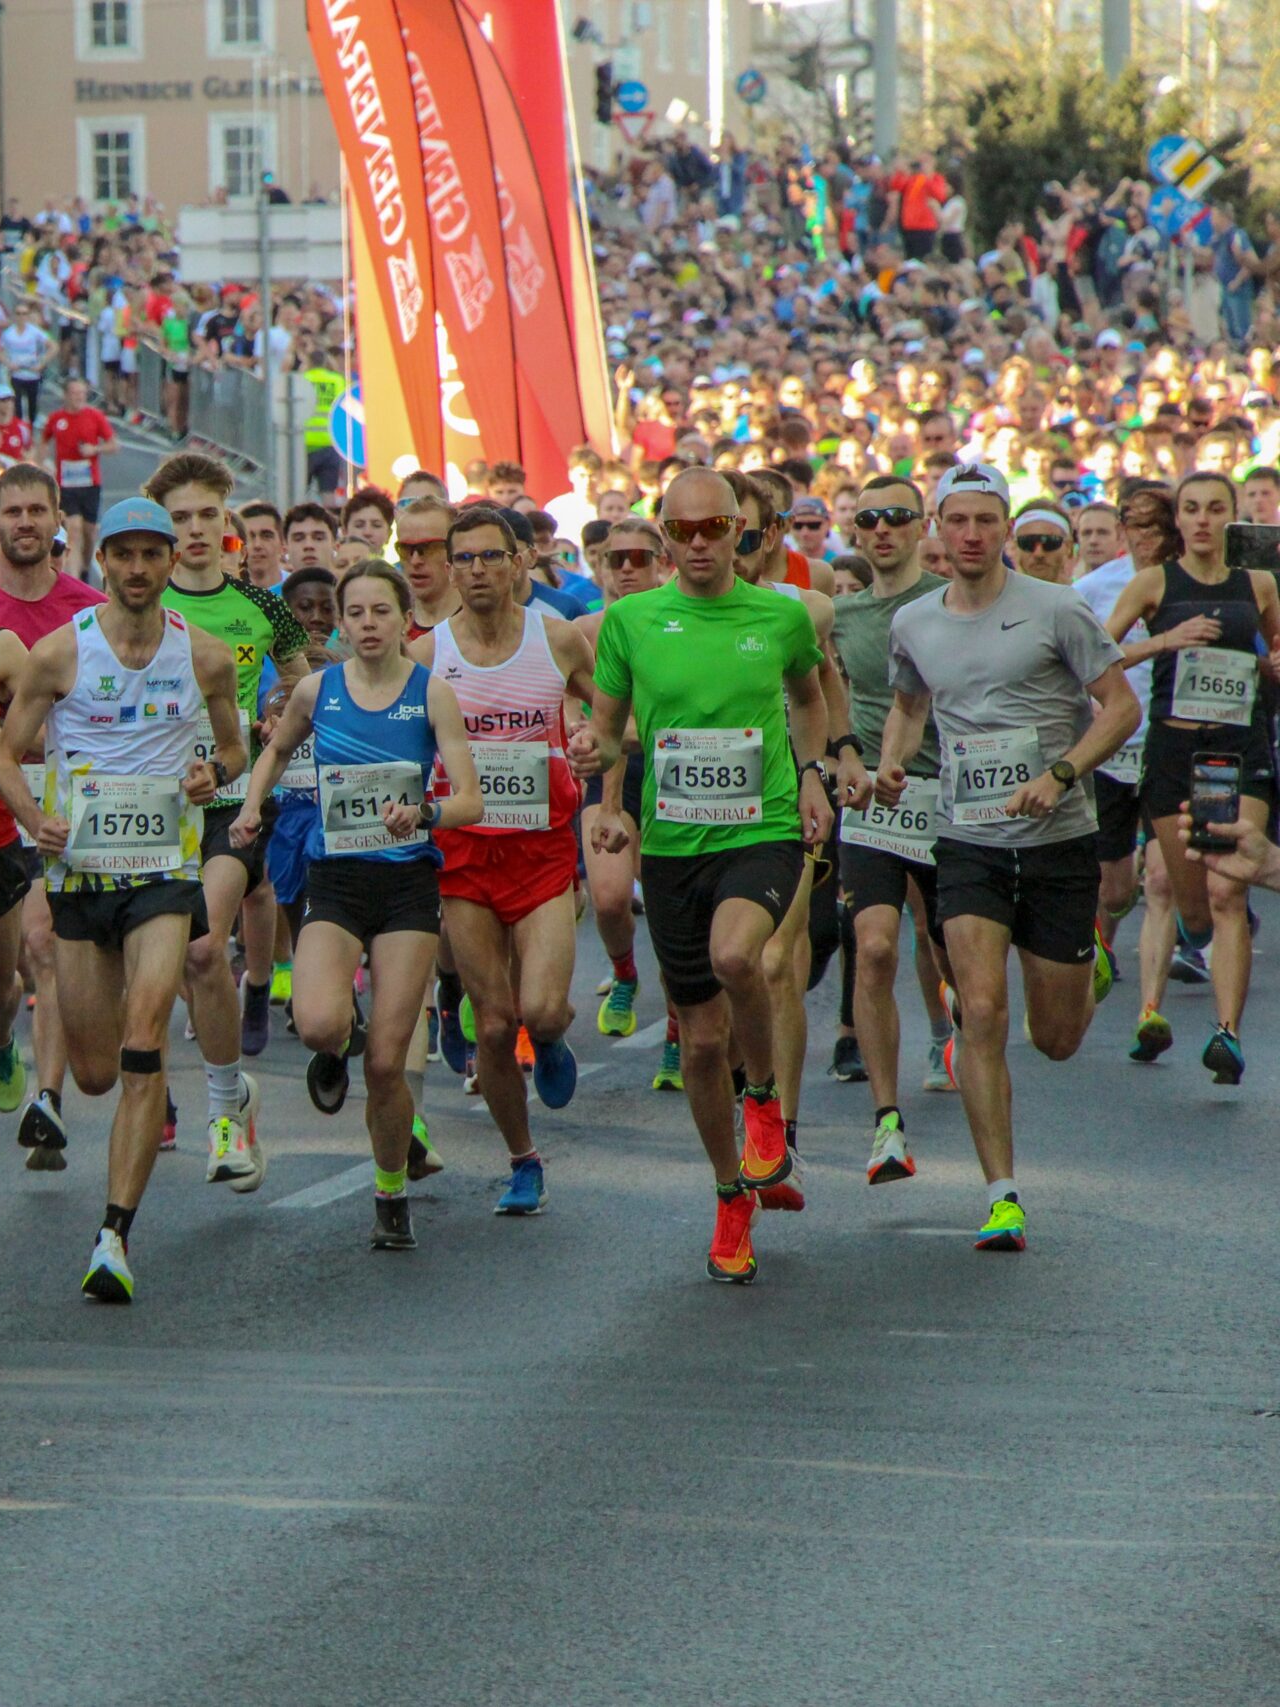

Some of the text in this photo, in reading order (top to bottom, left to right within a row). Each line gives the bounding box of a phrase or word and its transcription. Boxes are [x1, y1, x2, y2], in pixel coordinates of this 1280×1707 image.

[740, 643, 764, 651] WEGT
[1188, 675, 1246, 697] 15659
[464, 709, 545, 733] USTRIA
[693, 755, 721, 763] Florian
[479, 775, 535, 796] 5663
[670, 765, 747, 788] 15583
[962, 763, 1031, 790] 16728
[363, 786, 379, 794] Lisa
[115, 801, 138, 809] Lukas
[335, 792, 412, 819] 1514
[88, 813, 165, 836] 15793
[862, 806, 928, 831] 15766
[869, 836, 928, 860] GENERALI
[103, 855, 170, 869] GENERALI
